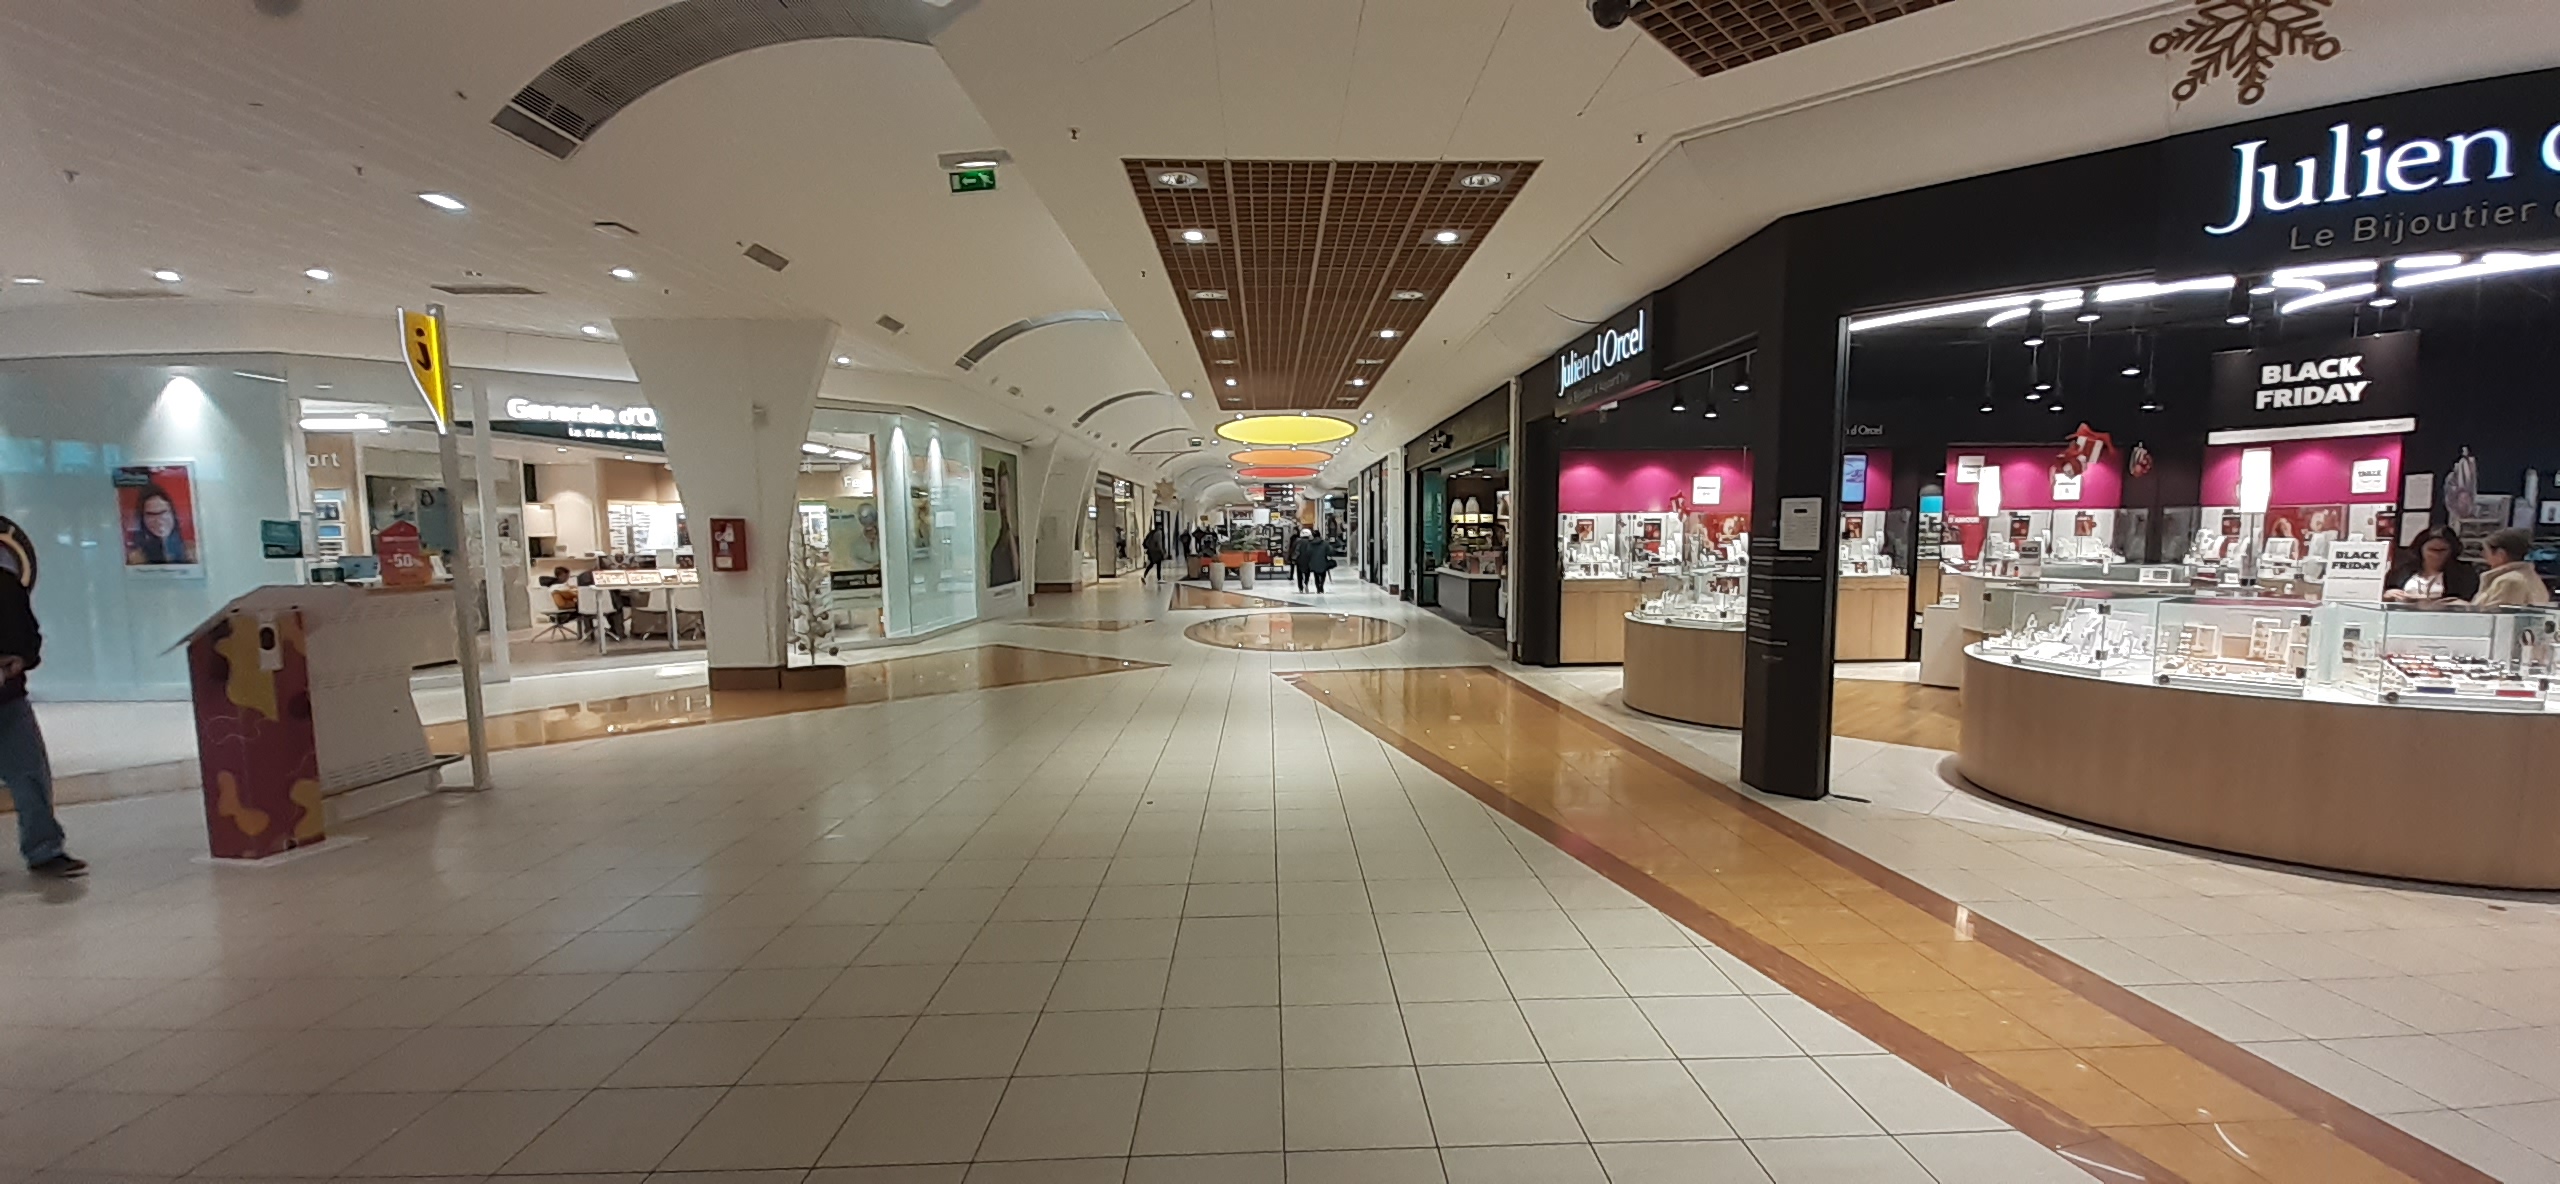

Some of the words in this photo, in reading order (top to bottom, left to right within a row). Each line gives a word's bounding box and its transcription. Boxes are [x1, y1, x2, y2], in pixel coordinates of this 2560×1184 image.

[2204, 124, 2514, 235] Julien
[2290, 226, 2336, 250] Le
[2353, 202, 2538, 244] Bijoutier
[1558, 350, 1591, 397] Julien
[2262, 356, 2364, 385] BLACK
[2255, 380, 2373, 410] FRIDAY
[2331, 561, 2381, 570] FRIDAY
[2335, 551, 2380, 560] BLACK
